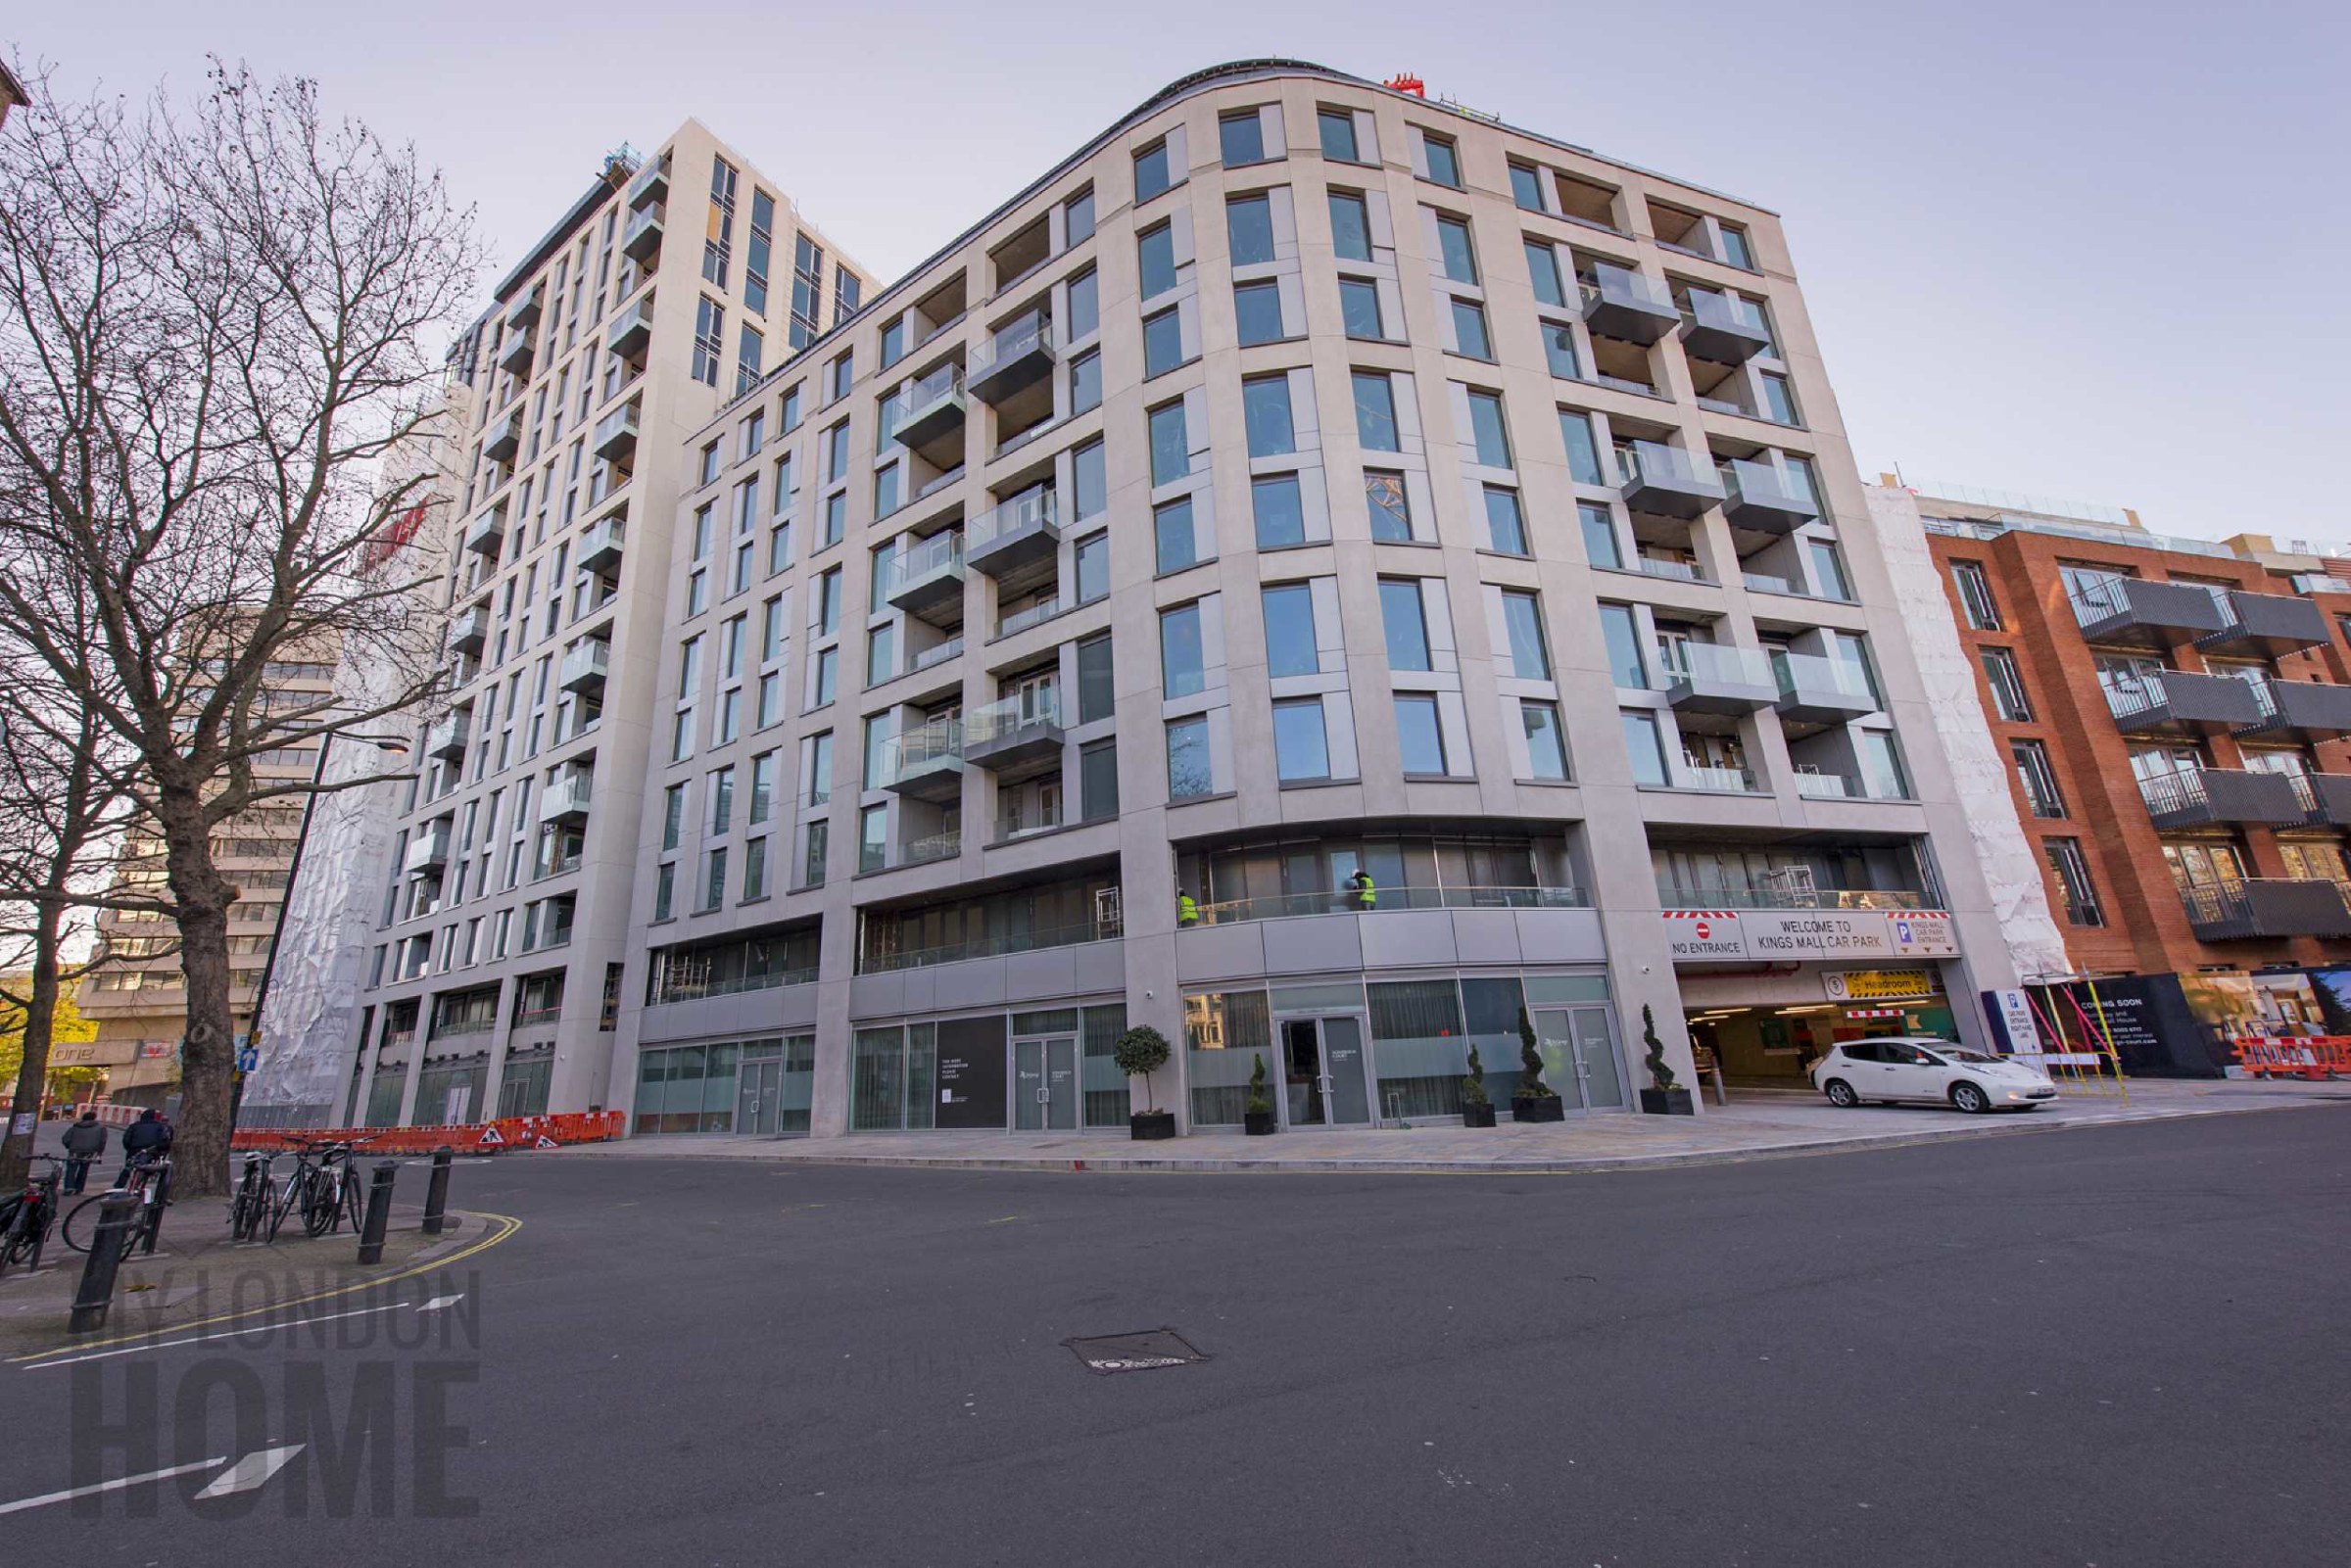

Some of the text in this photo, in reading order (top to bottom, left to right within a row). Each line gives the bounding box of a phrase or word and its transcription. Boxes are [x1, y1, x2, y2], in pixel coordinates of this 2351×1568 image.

[1780, 921, 1851, 933] WELCOME TO
[1899, 925, 1908, 940] P
[1672, 942, 1741, 954] NO ENTRANCE
[1758, 936, 1882, 949] KINGS MALL CAR PARK
[1865, 979, 1912, 989] Headroom
[2081, 1000, 2115, 1010] CONG
